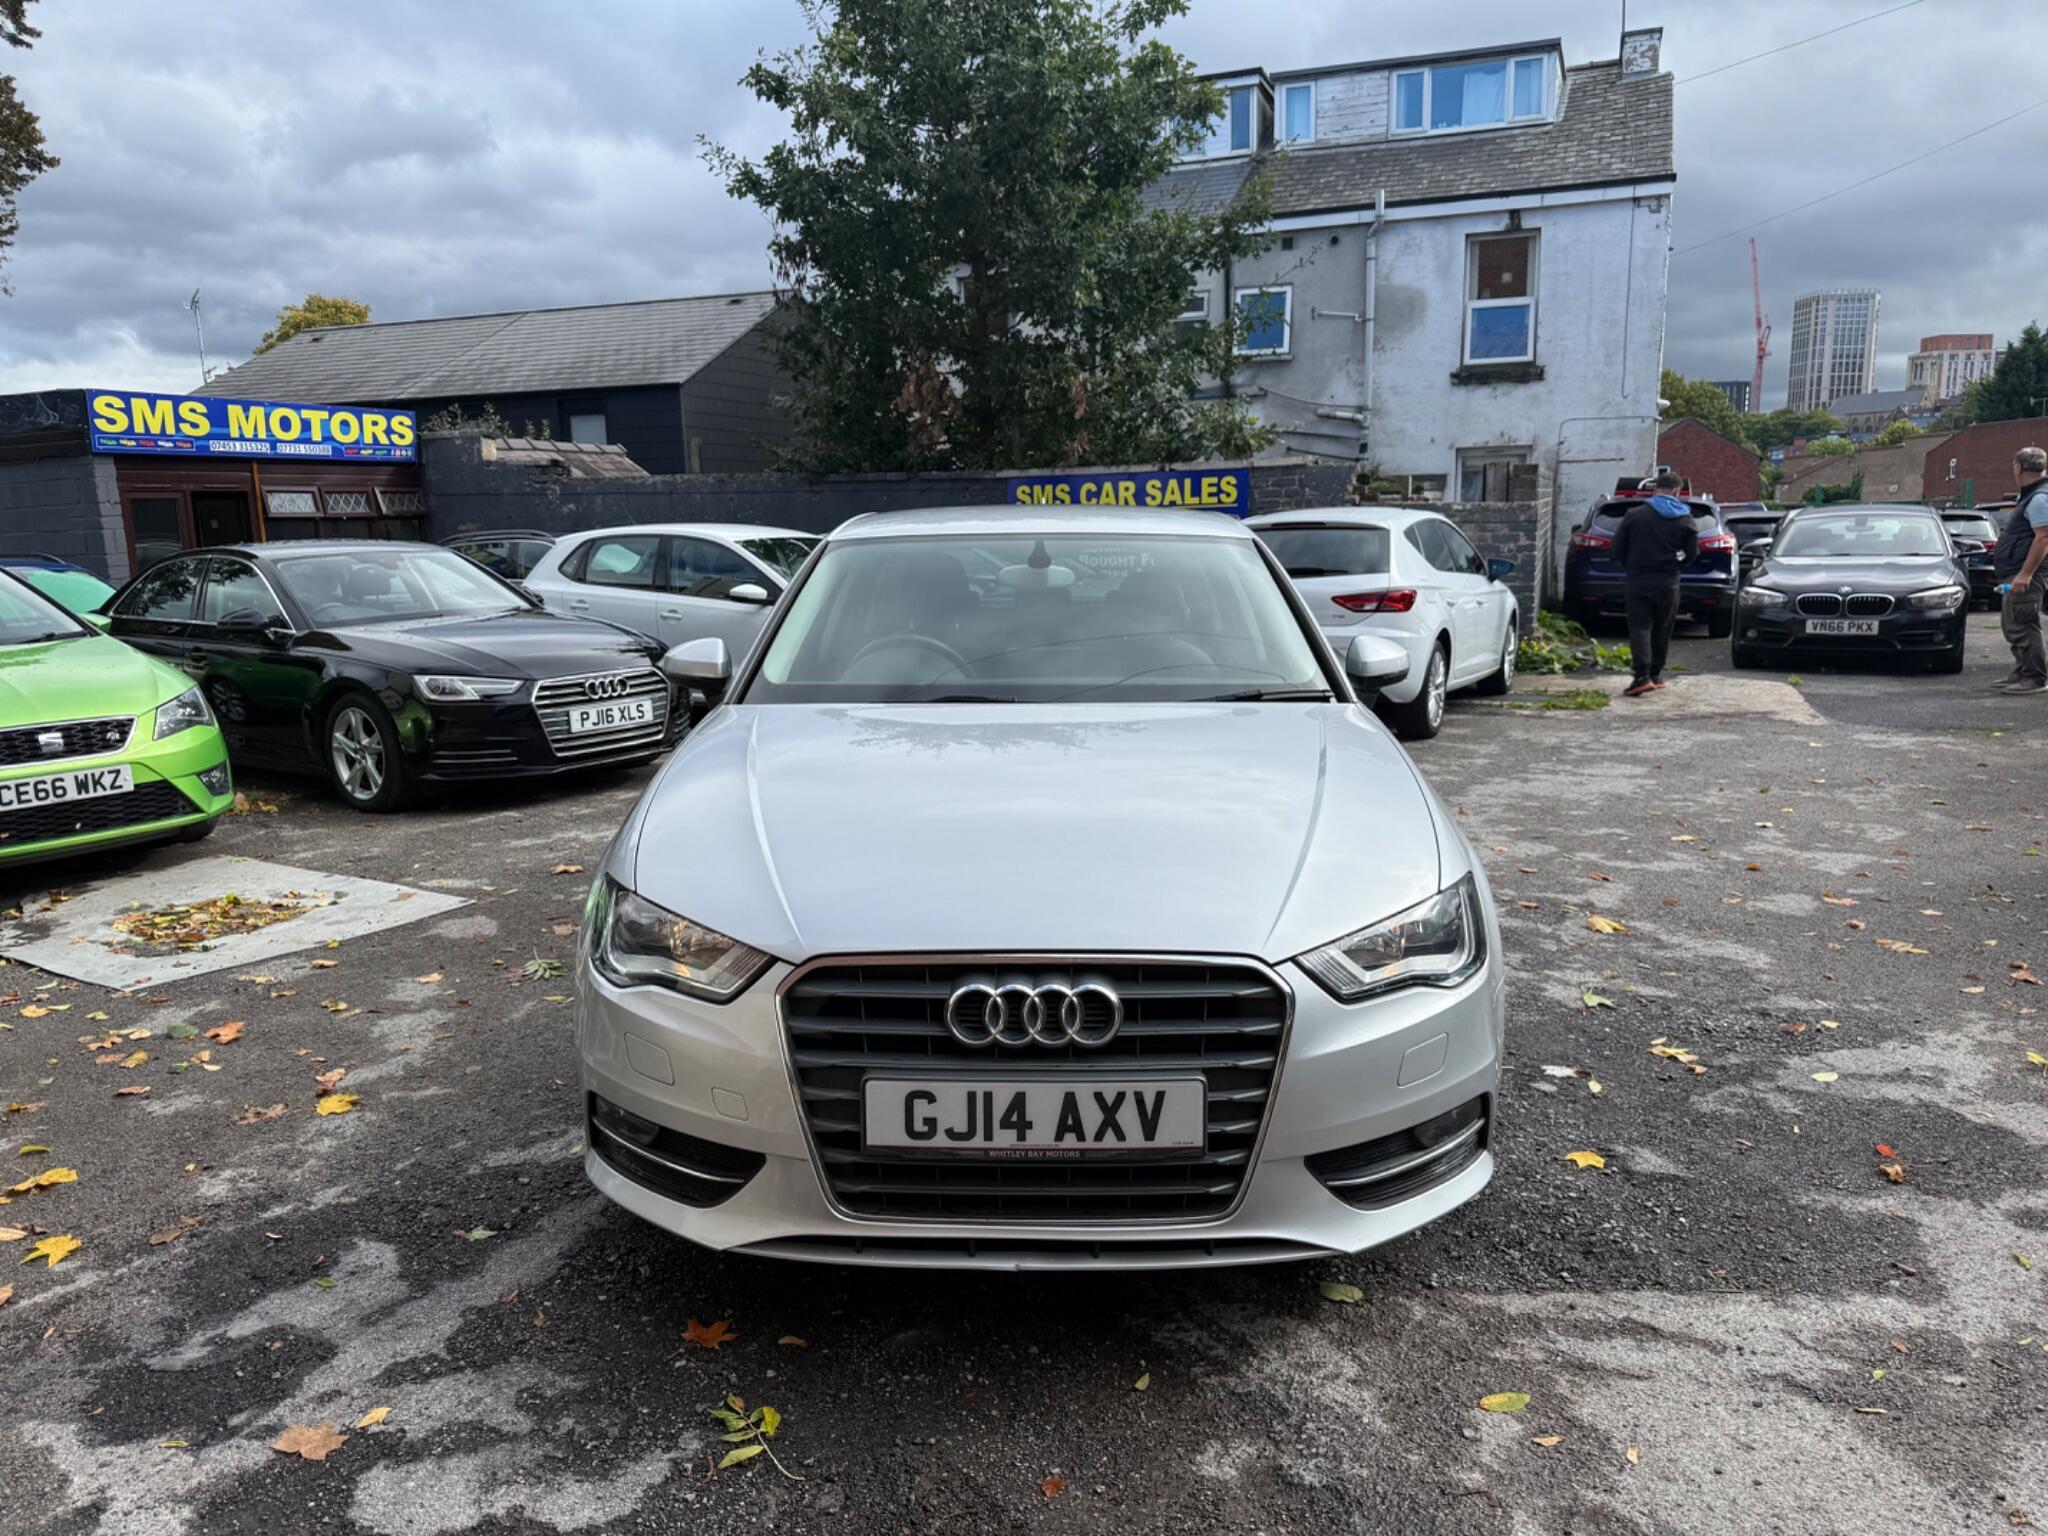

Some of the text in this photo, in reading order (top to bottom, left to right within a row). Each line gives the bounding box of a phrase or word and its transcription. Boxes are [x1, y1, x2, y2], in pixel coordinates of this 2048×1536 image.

[92, 395, 415, 446] SMS MOTORS
[1015, 476, 1238, 507] SMS CAR SALES
[1811, 621, 1873, 633] VN66 PKX
[579, 703, 645, 728] PJ16 XLS
[0, 768, 124, 807] CE66 WKZ
[904, 1089, 1167, 1143] GJ14 AXV
[988, 1150, 1081, 1159] WHITLEY BAY MOTORS
